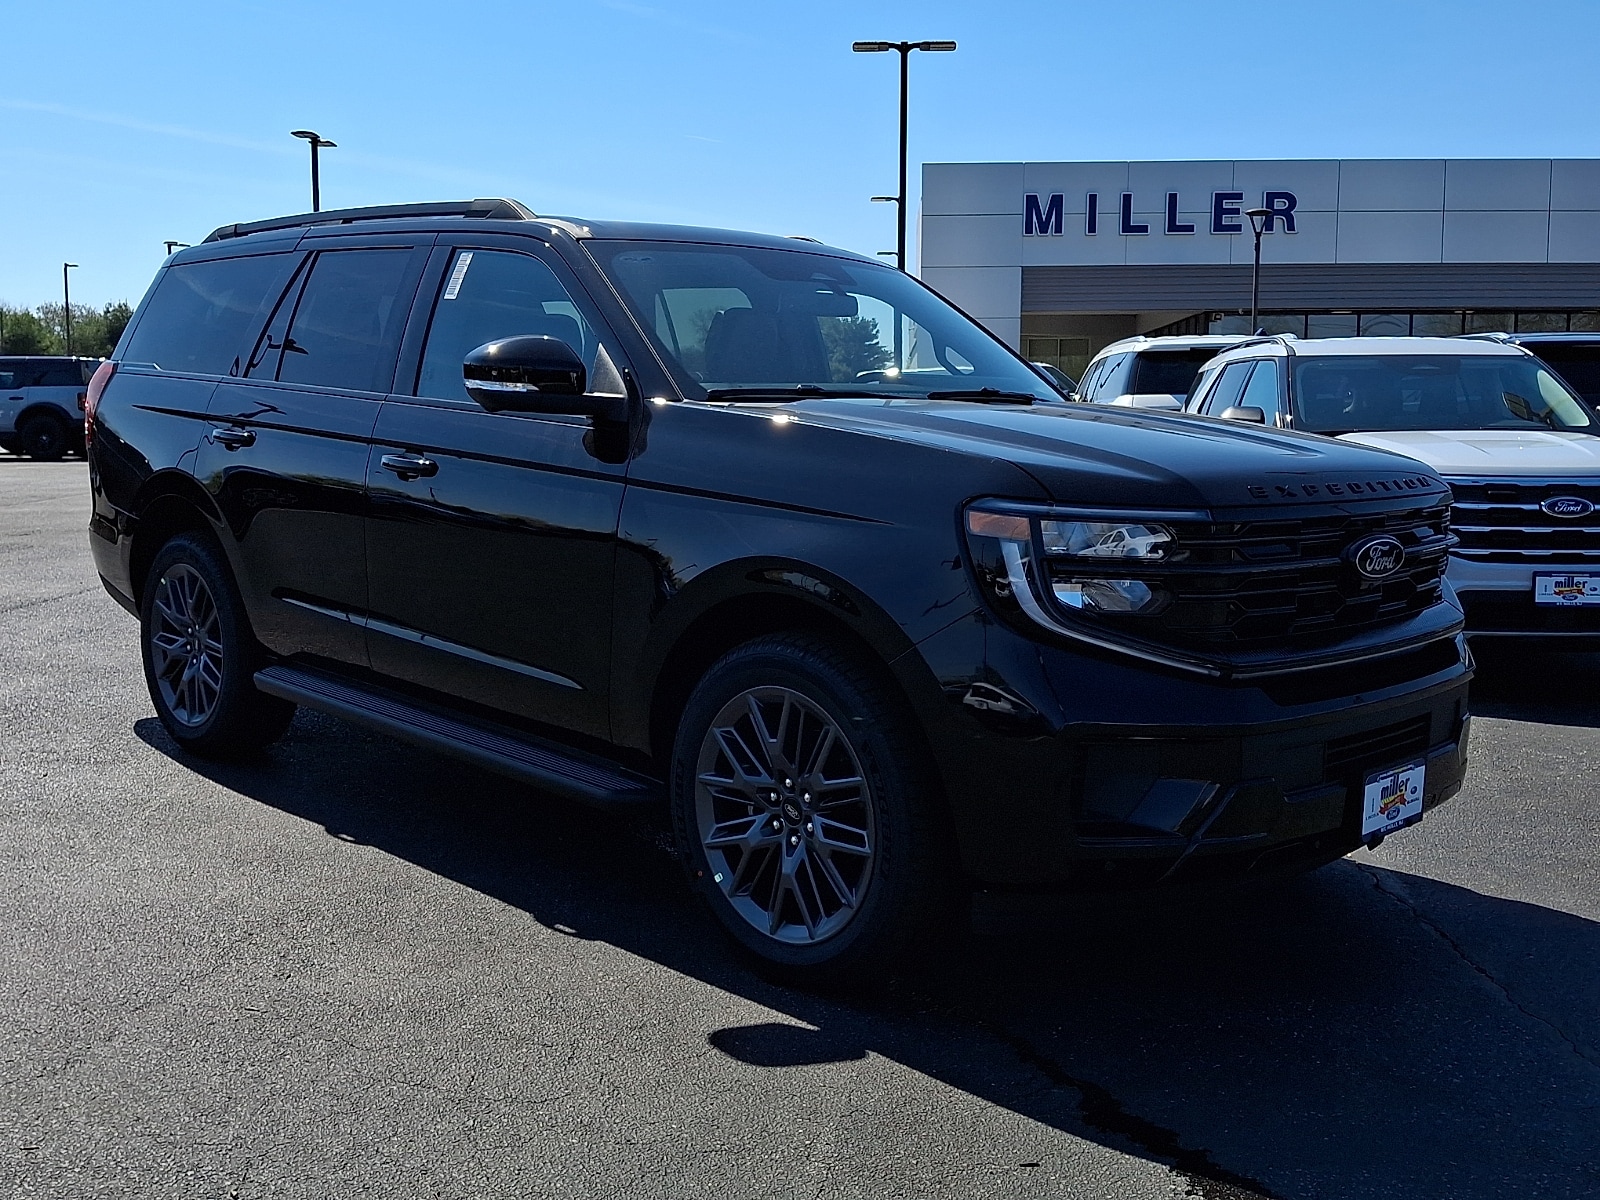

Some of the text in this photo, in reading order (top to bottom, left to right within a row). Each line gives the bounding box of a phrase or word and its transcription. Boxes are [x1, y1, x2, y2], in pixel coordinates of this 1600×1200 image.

[1023, 191, 1298, 236] MILLER
[1248, 476, 1432, 500] EXPEDITION
[1555, 500, 1582, 512] Ford
[1366, 545, 1400, 571] Ford
[1554, 576, 1588, 589] miller
[1380, 774, 1411, 801] miller
